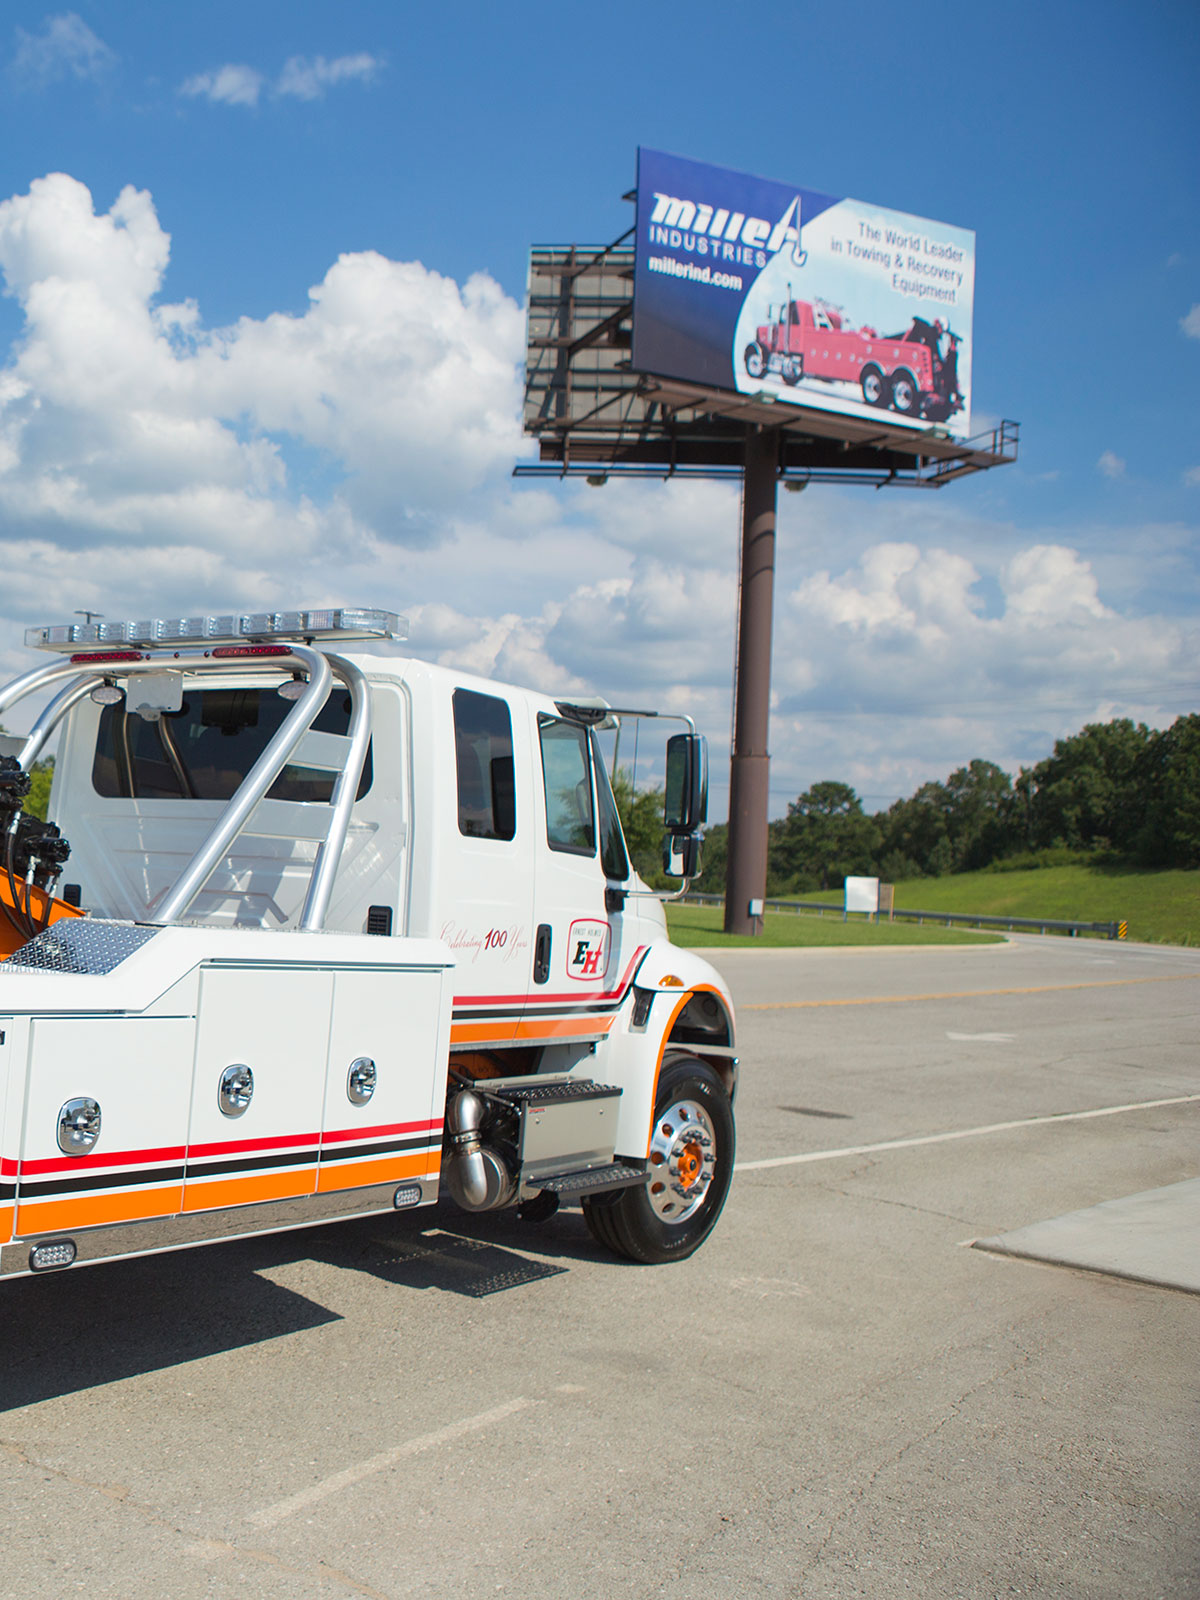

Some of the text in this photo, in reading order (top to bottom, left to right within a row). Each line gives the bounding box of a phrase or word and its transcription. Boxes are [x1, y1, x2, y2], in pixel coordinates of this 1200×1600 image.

[649, 225, 766, 268] INDUSTRIES
[859, 221, 963, 263] The World Leader
[648, 255, 743, 292] millerind.com
[830, 237, 964, 287] in Towing & Recovery
[892, 273, 957, 302] Equipment
[484, 928, 508, 951] 100
